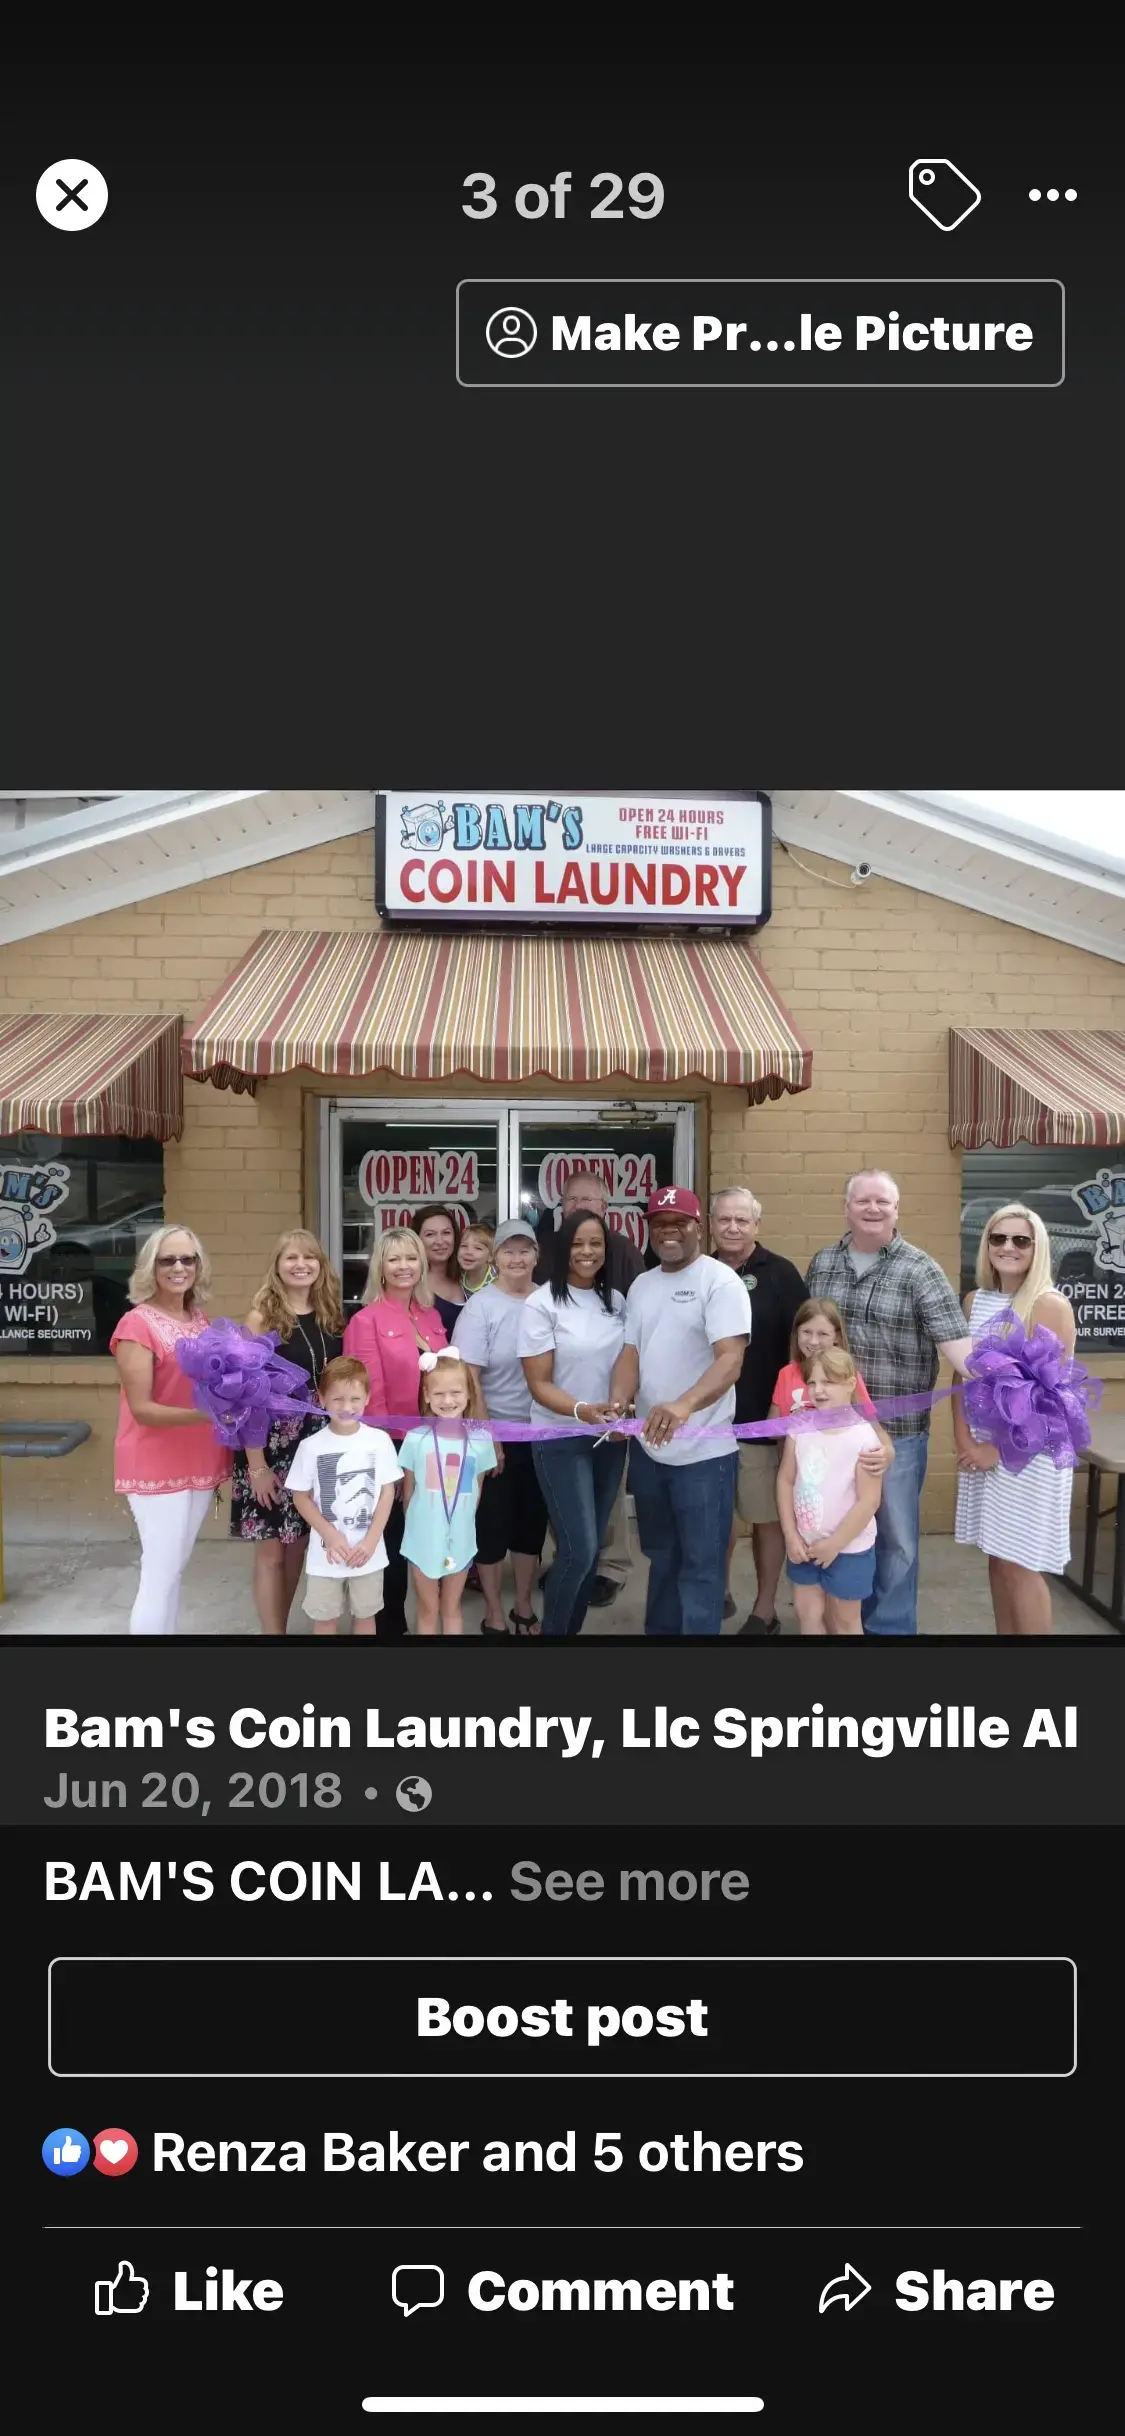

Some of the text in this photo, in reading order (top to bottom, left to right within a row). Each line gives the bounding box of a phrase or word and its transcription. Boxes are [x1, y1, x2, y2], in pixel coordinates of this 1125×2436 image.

[452, 801, 583, 851] BAM'S
[619, 808, 724, 825] OPEN 24 HOURS
[636, 825, 708, 841] FREE WI-FI
[586, 843, 613, 854] LARGE
[615, 844, 658, 855] CAPACITY
[661, 845, 702, 856] WASHERS
[712, 847, 746, 857] DRYERS
[400, 858, 748, 907] COIN LAUNDRY
[365, 1155, 474, 1200] (OPEN 24
[624, 1159, 653, 1197] 24
[658, 1189, 677, 1206] A
[9, 1283, 84, 1304] HOURS)
[1113, 1284, 1125, 1299] 2
[4, 1305, 59, 1326] WI-FI)
[1077, 1305, 1125, 1324] (FREE
[37, 1329, 91, 1341] SECURITY)
